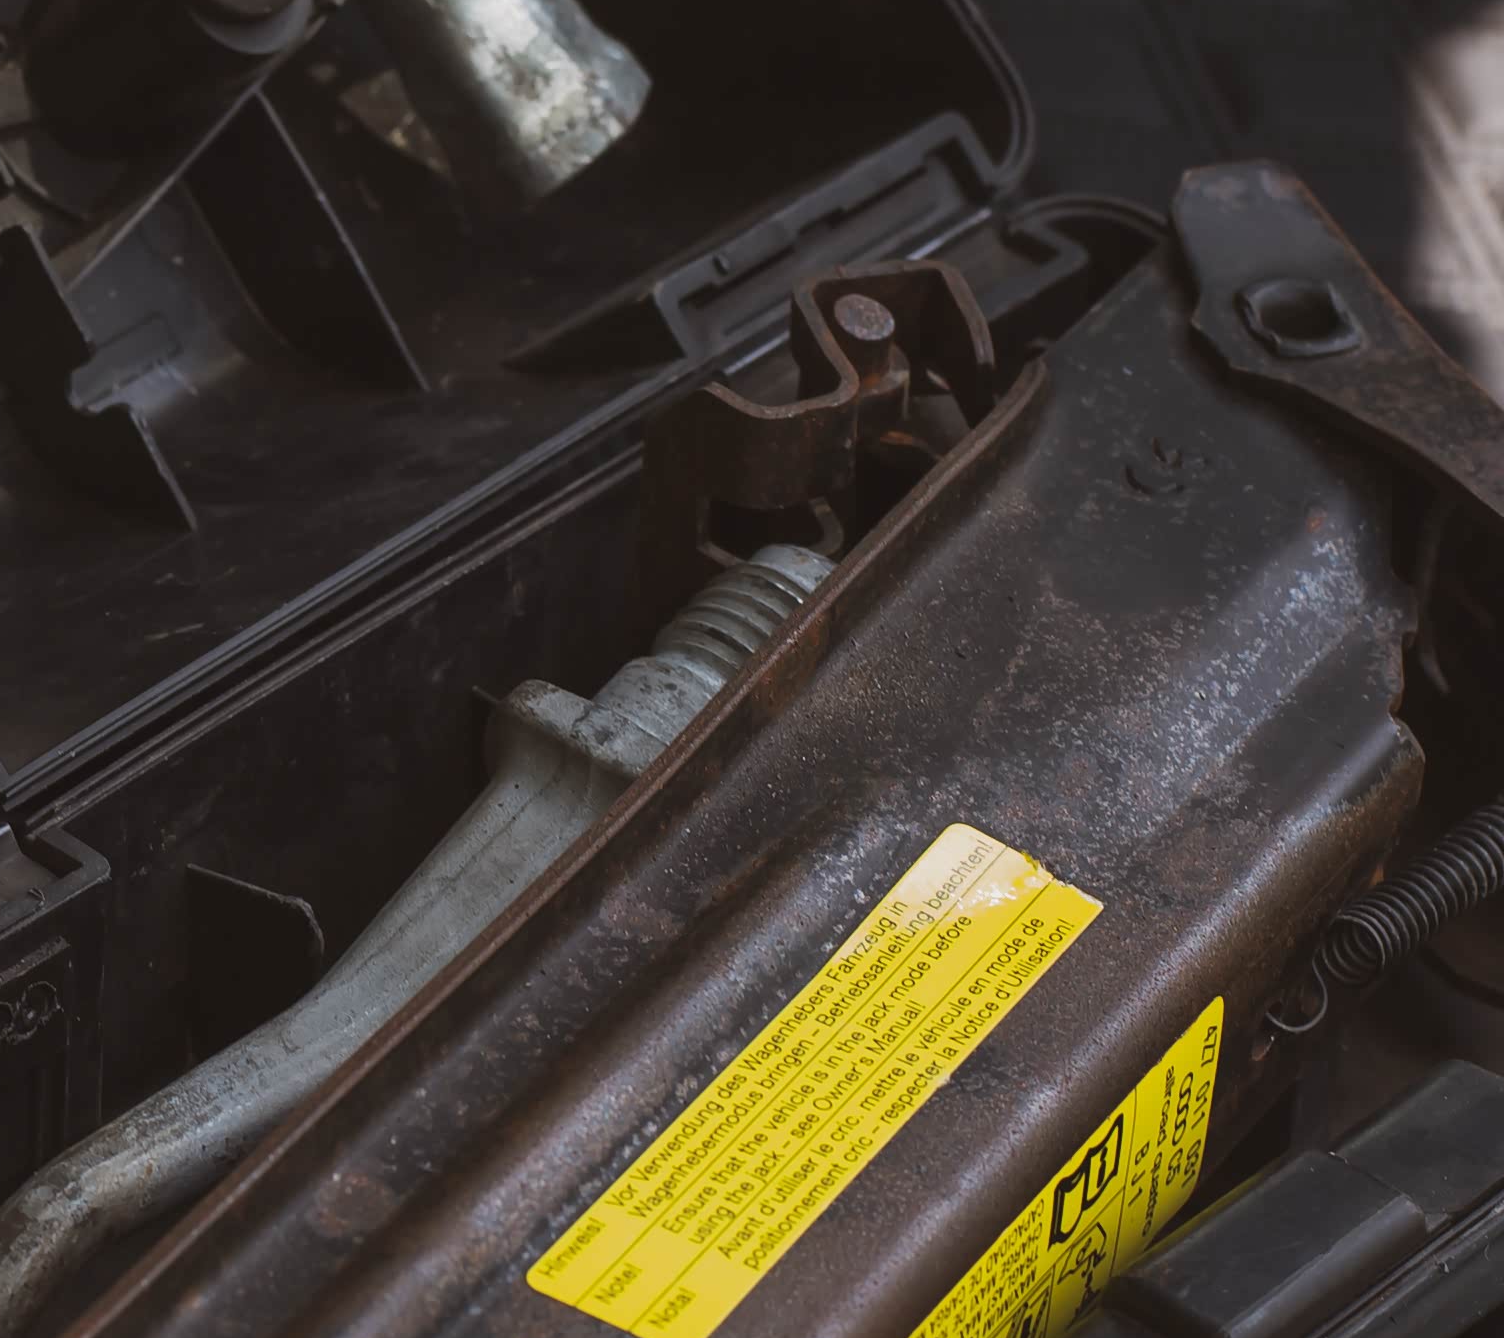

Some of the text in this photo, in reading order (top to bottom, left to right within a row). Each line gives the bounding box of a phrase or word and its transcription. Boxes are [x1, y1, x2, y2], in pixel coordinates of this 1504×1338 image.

[604, 901, 908, 1206] Vor Verwendung des Wagenhebers Fahrzeug in
[627, 1090, 763, 1218] Wagenhebermodus
[753, 1039, 814, 1089] bringen
[814, 910, 934, 1027] Betriebsanleitung
[921, 839, 993, 910] beachten!
[661, 916, 971, 1233] Ensure that the vehicle is in the jack mode before
[717, 1216, 764, 1259] Avant
[759, 1156, 818, 1216] d'utiliser
[809, 1143, 834, 1157] le
[859, 1067, 906, 1111] mettre
[895, 1052, 919, 1066] le
[914, 996, 971, 1049] véhicule
[968, 977, 990, 995] en
[985, 937, 1026, 976] mode
[1021, 918, 1044, 936] de
[742, 1162, 848, 1270] positionnement
[843, 1136, 873, 1162] cric
[879, 1059, 943, 1124] respecter
[933, 1046, 959, 1060] la
[948, 1001, 999, 1045] Notice
[994, 918, 1074, 1000] d'Utilisation!
[1157, 1065, 1175, 1148] allroad
[1191, 1079, 1211, 1131] 011
[688, 1205, 739, 1249] using
[723, 1181, 754, 1204] the
[745, 1150, 785, 1185] jack
[790, 1113, 820, 1138] see
[812, 1056, 874, 1111] Owner's
[864, 999, 925, 1055] Manual!
[1166, 1148, 1184, 1187] C5
[537, 1216, 605, 1278] Hinweis!
[593, 1262, 641, 1304] Note!
[647, 1287, 695, 1328] Nota!
